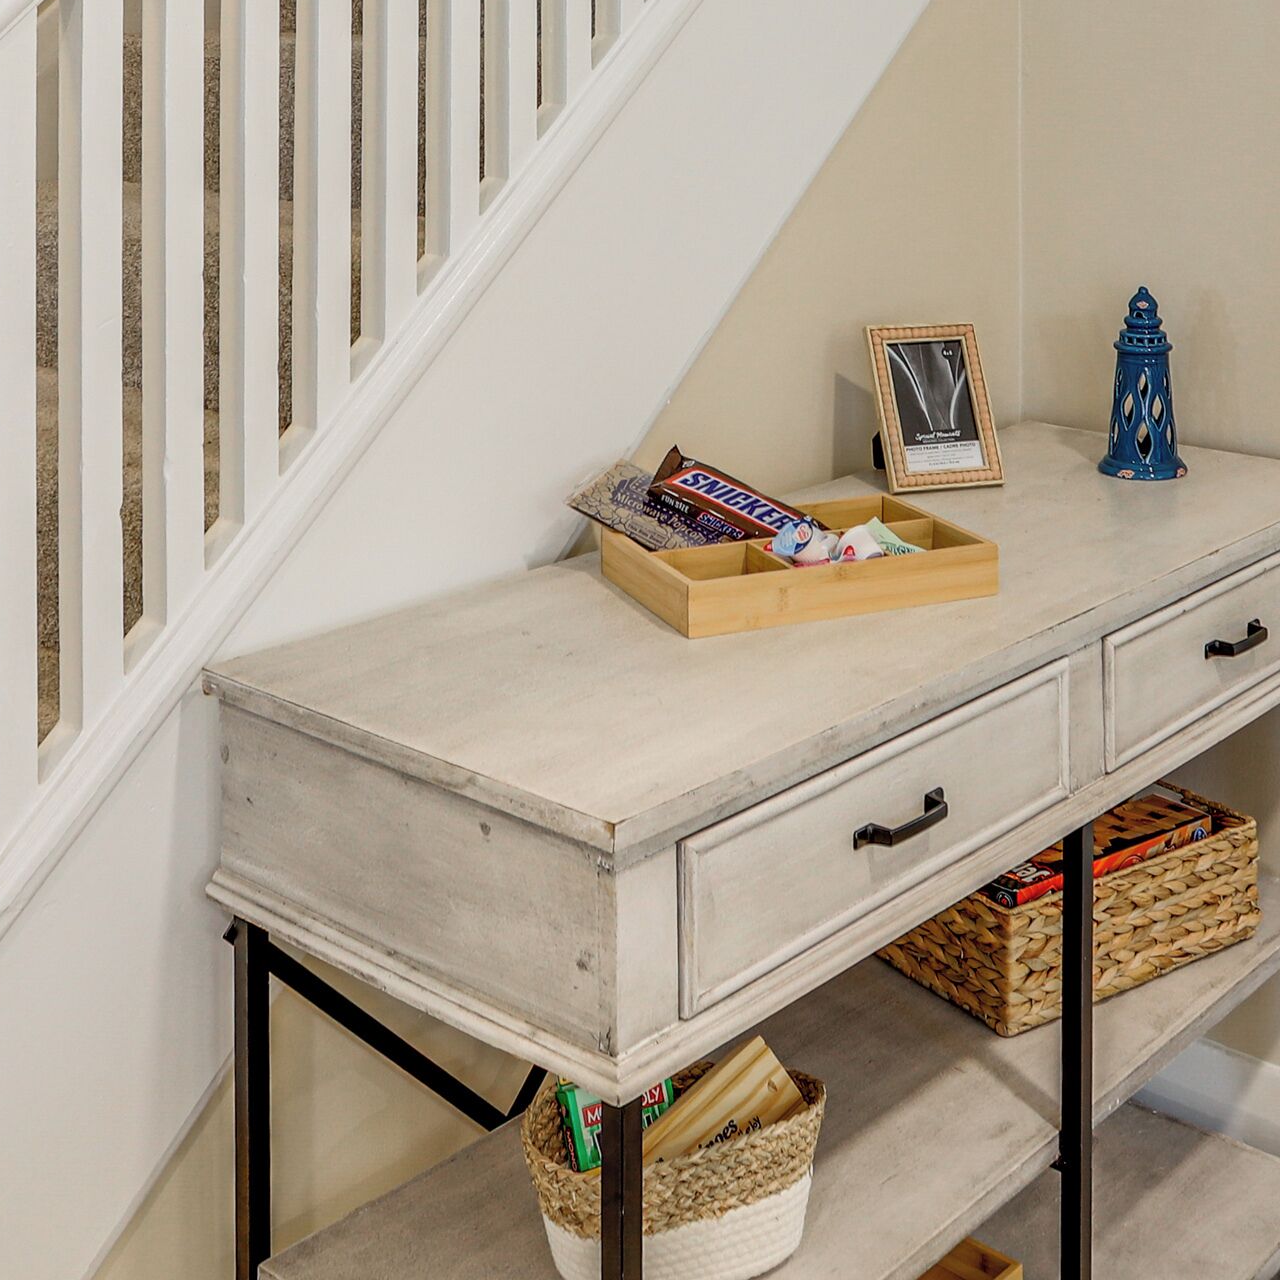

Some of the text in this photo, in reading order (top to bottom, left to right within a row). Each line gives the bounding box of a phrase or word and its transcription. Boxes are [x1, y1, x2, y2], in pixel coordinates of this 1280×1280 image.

[613, 492, 668, 522] Microwave
[667, 516, 708, 544] Popcorn
[661, 494, 690, 514] FUN SIZE
[679, 472, 795, 531] SNICKER
[699, 513, 743, 539] SNICKERS
[566, 1130, 578, 1172] MONO
